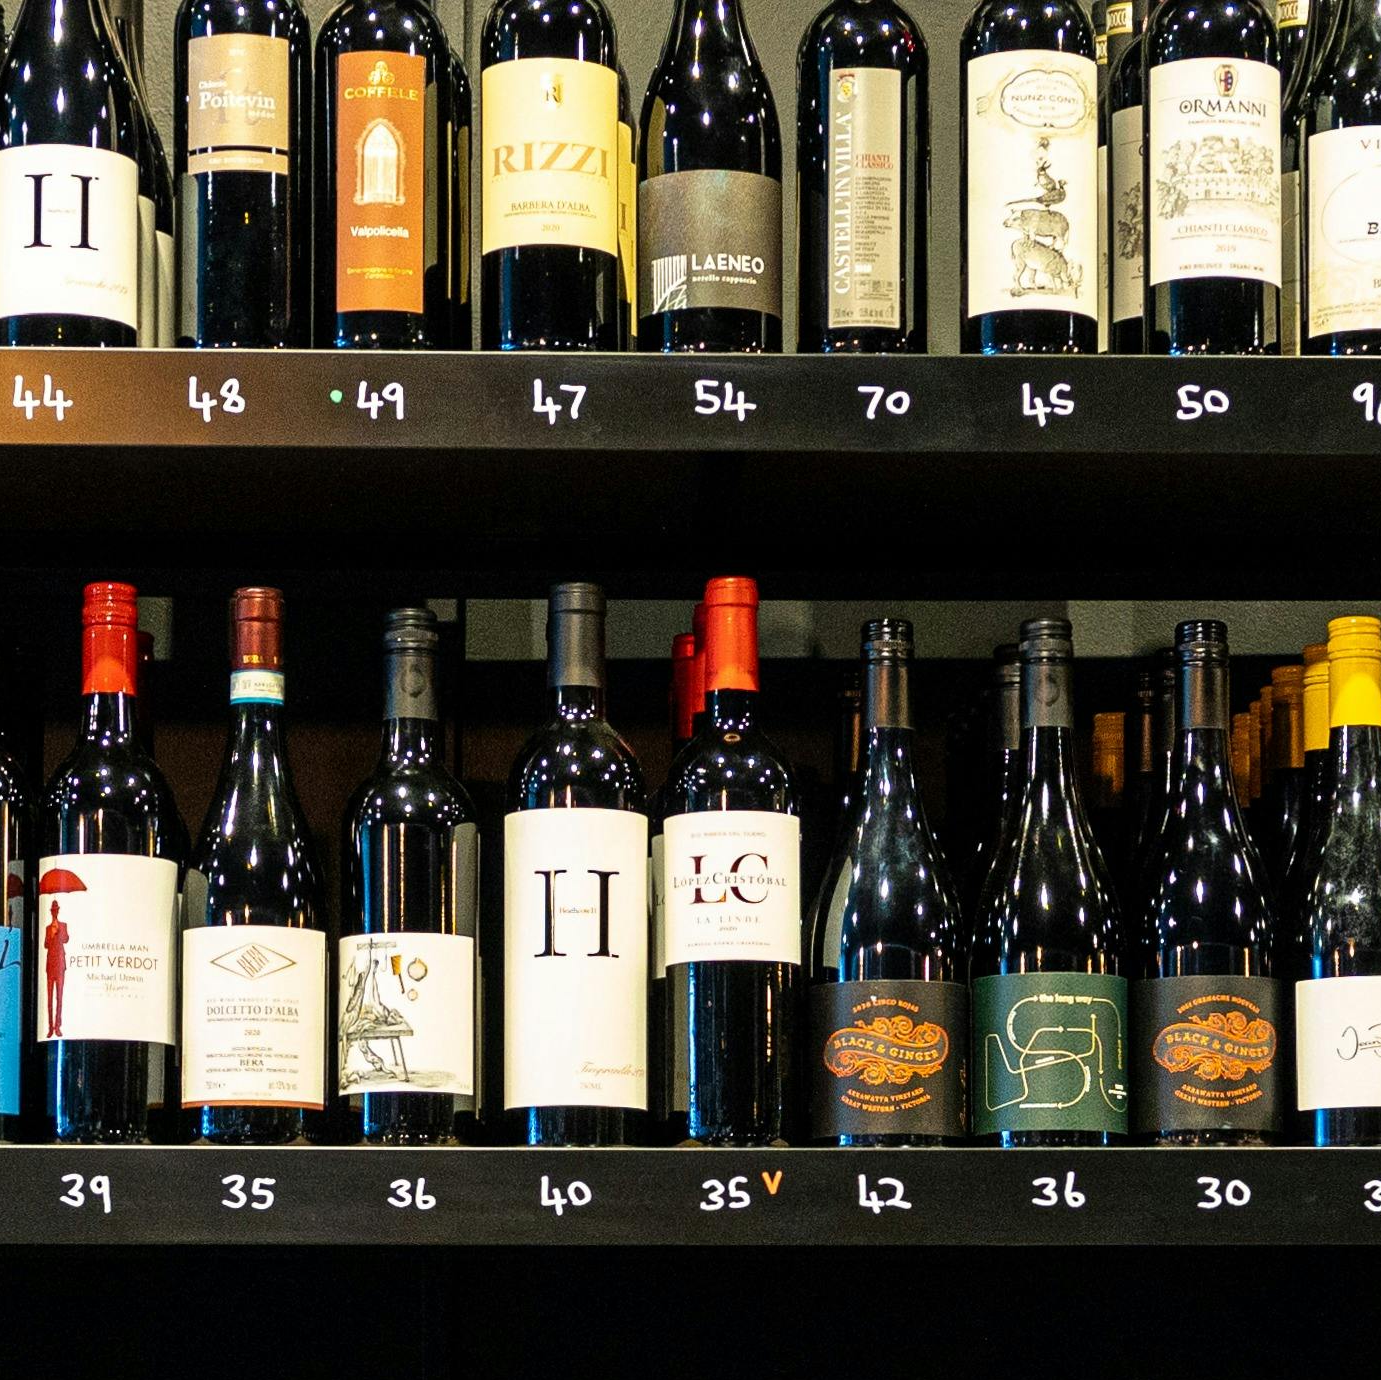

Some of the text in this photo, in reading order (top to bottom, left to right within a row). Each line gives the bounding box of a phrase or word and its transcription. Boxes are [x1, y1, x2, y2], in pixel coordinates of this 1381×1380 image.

[1180, 98, 1266, 118] ORMANNI
[493, 142, 608, 177] RIZZI
[350, 226, 409, 238] Valpolicella
[692, 253, 765, 274] LAENEO
[12, 374, 74, 421] 44
[188, 375, 246, 423] 48
[356, 380, 405, 421] 49
[532, 378, 587, 426] 47
[694, 379, 757, 422] 54
[857, 385, 911, 420] 70
[1021, 382, 1075, 428] 45
[1176, 384, 1230, 421] 50
[70, 955, 159, 970] PETIT VERDOT
[129, 944, 149, 952] MAN
[59, 1172, 112, 1214] 39
[219, 1173, 277, 1210] 35
[386, 1177, 437, 1211] 36
[540, 1175, 593, 1217] 40
[699, 1175, 751, 1212] 35
[857, 1173, 913, 1215] 42
[1031, 1170, 1086, 1208] 36
[1196, 1176, 1252, 1210] 30
